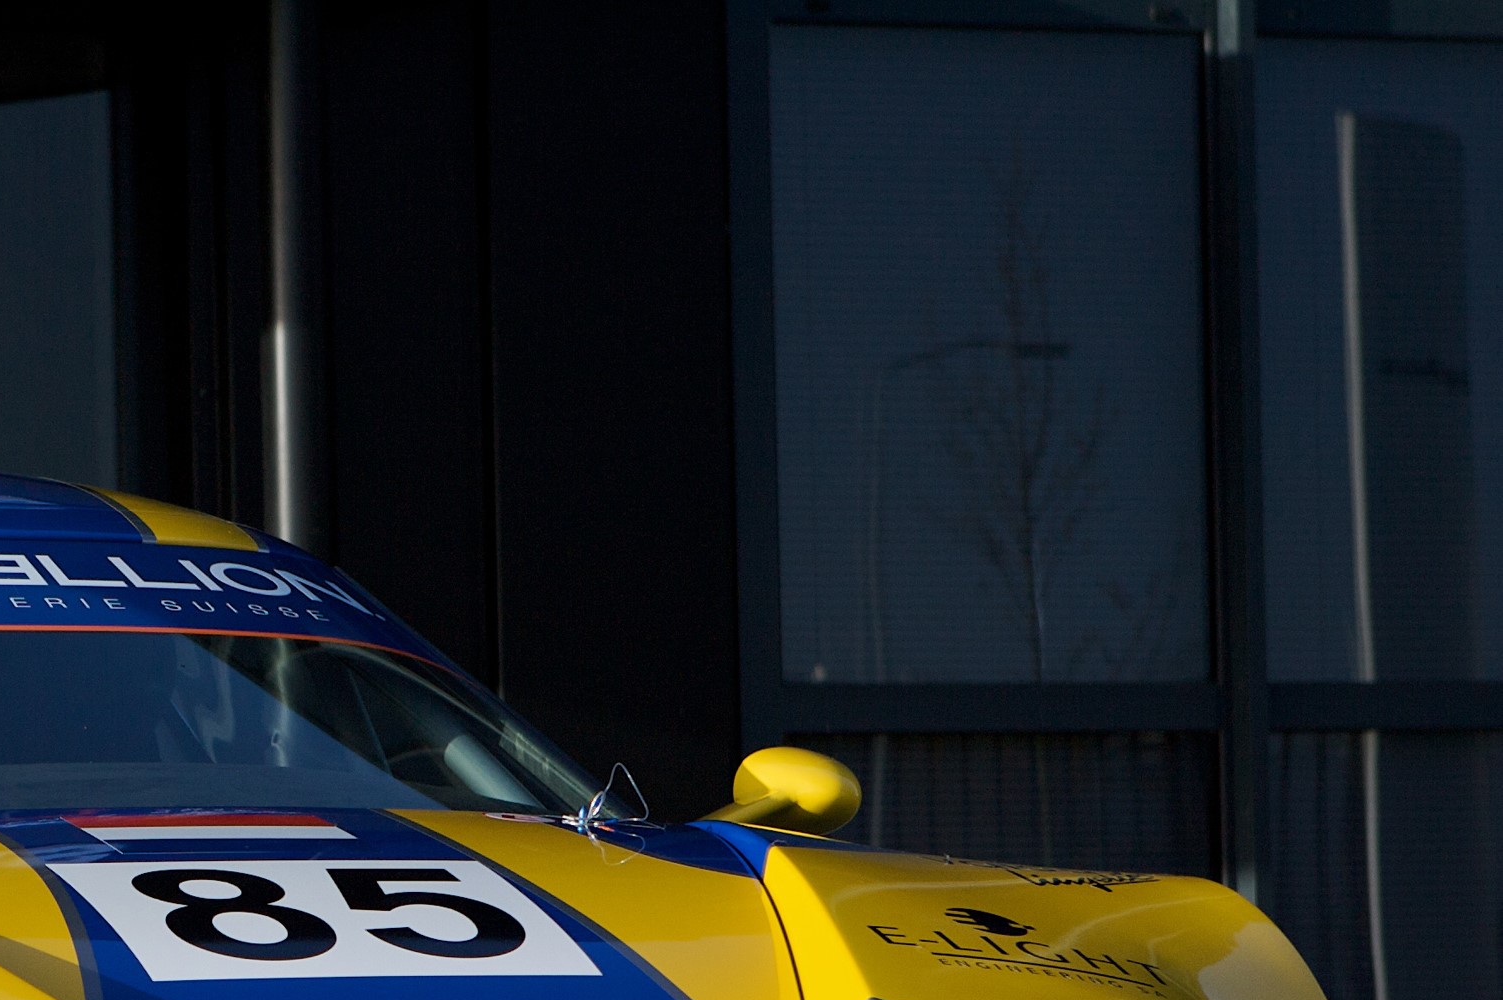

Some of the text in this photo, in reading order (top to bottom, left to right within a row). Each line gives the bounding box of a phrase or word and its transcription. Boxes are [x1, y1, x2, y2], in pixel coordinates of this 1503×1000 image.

[160, 599, 330, 623] SUISSE
[131, 868, 526, 961] 85
[867, 925, 1167, 987] E-LIGHT
[937, 957, 1125, 989] ENGINEERING
